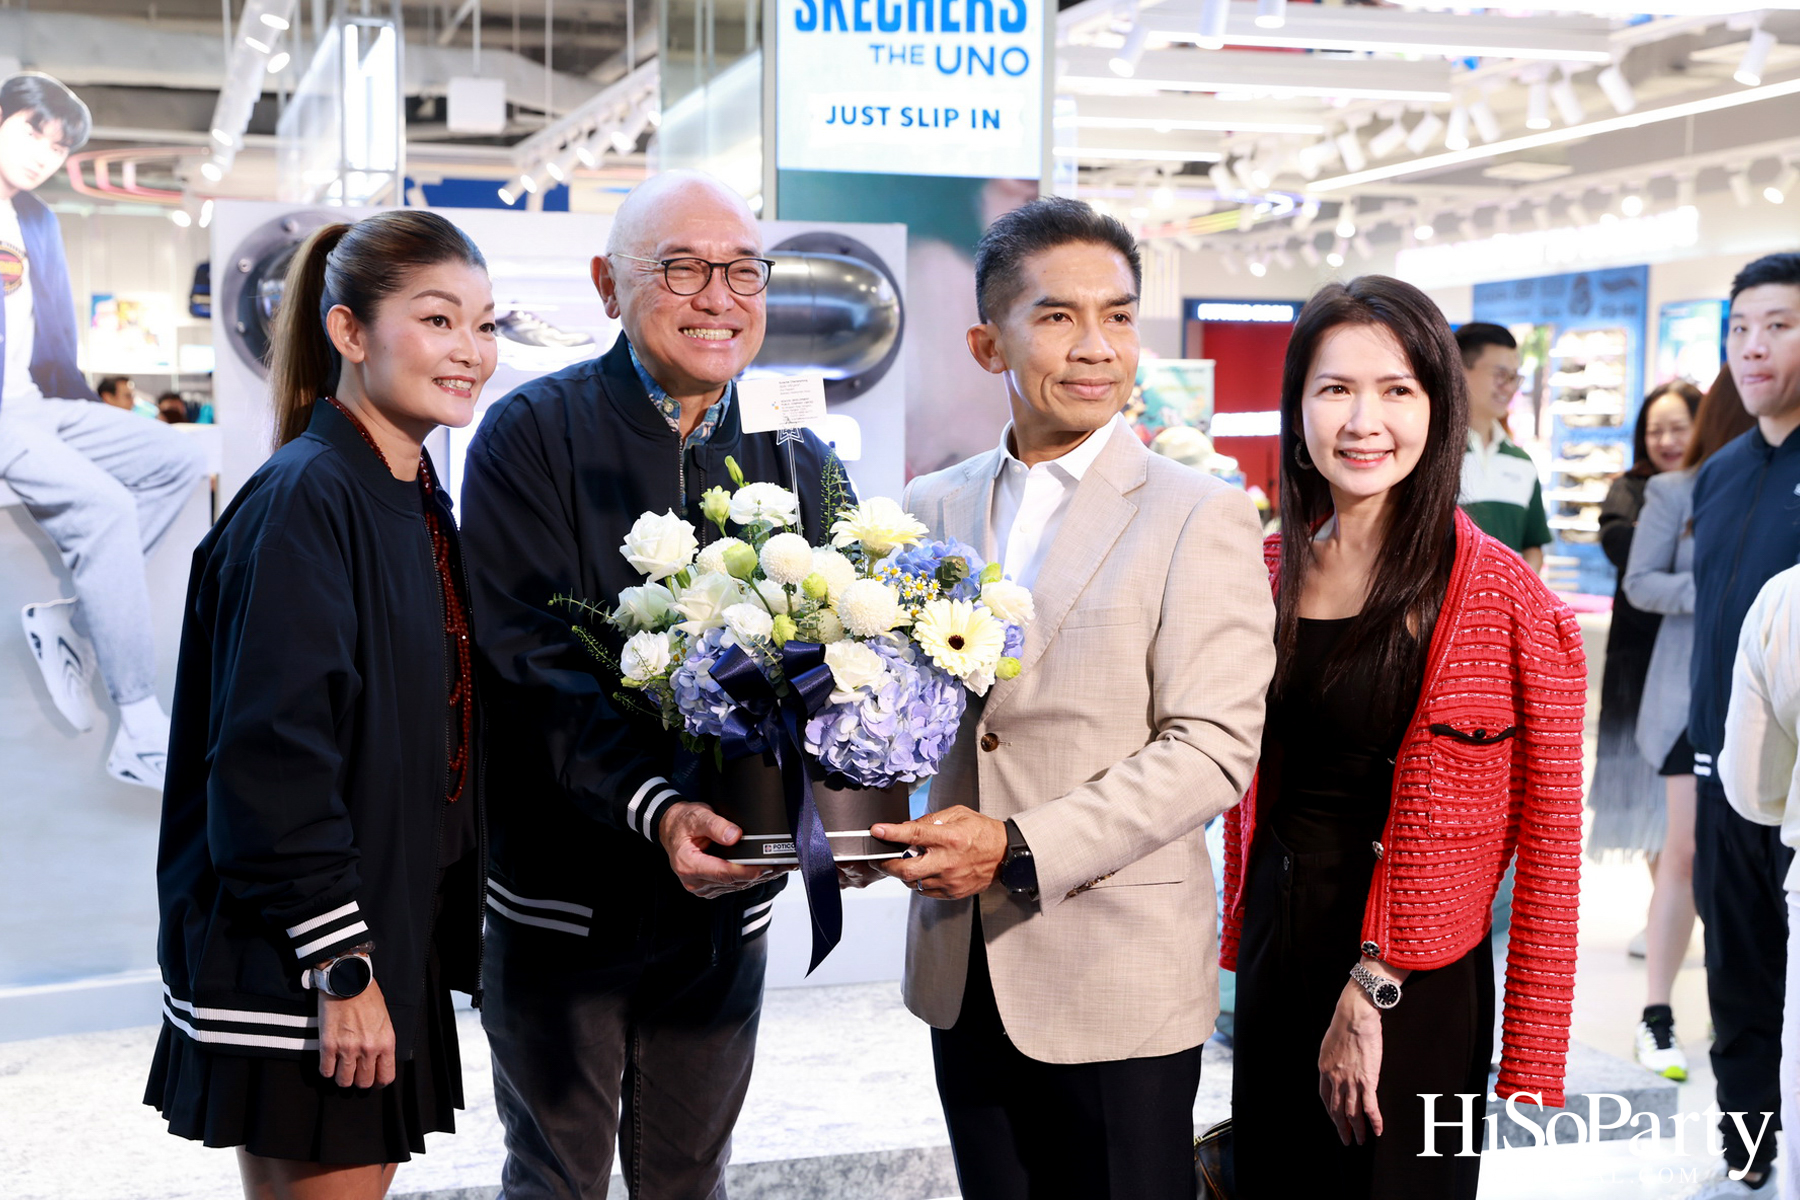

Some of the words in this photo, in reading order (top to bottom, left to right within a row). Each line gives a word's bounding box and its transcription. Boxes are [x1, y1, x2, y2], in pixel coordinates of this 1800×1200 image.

[869, 44, 924, 65] THE
[936, 45, 1029, 77] UNO
[826, 105, 891, 126] JUST
[901, 107, 959, 128] SLIP
[971, 108, 1000, 129] IN
